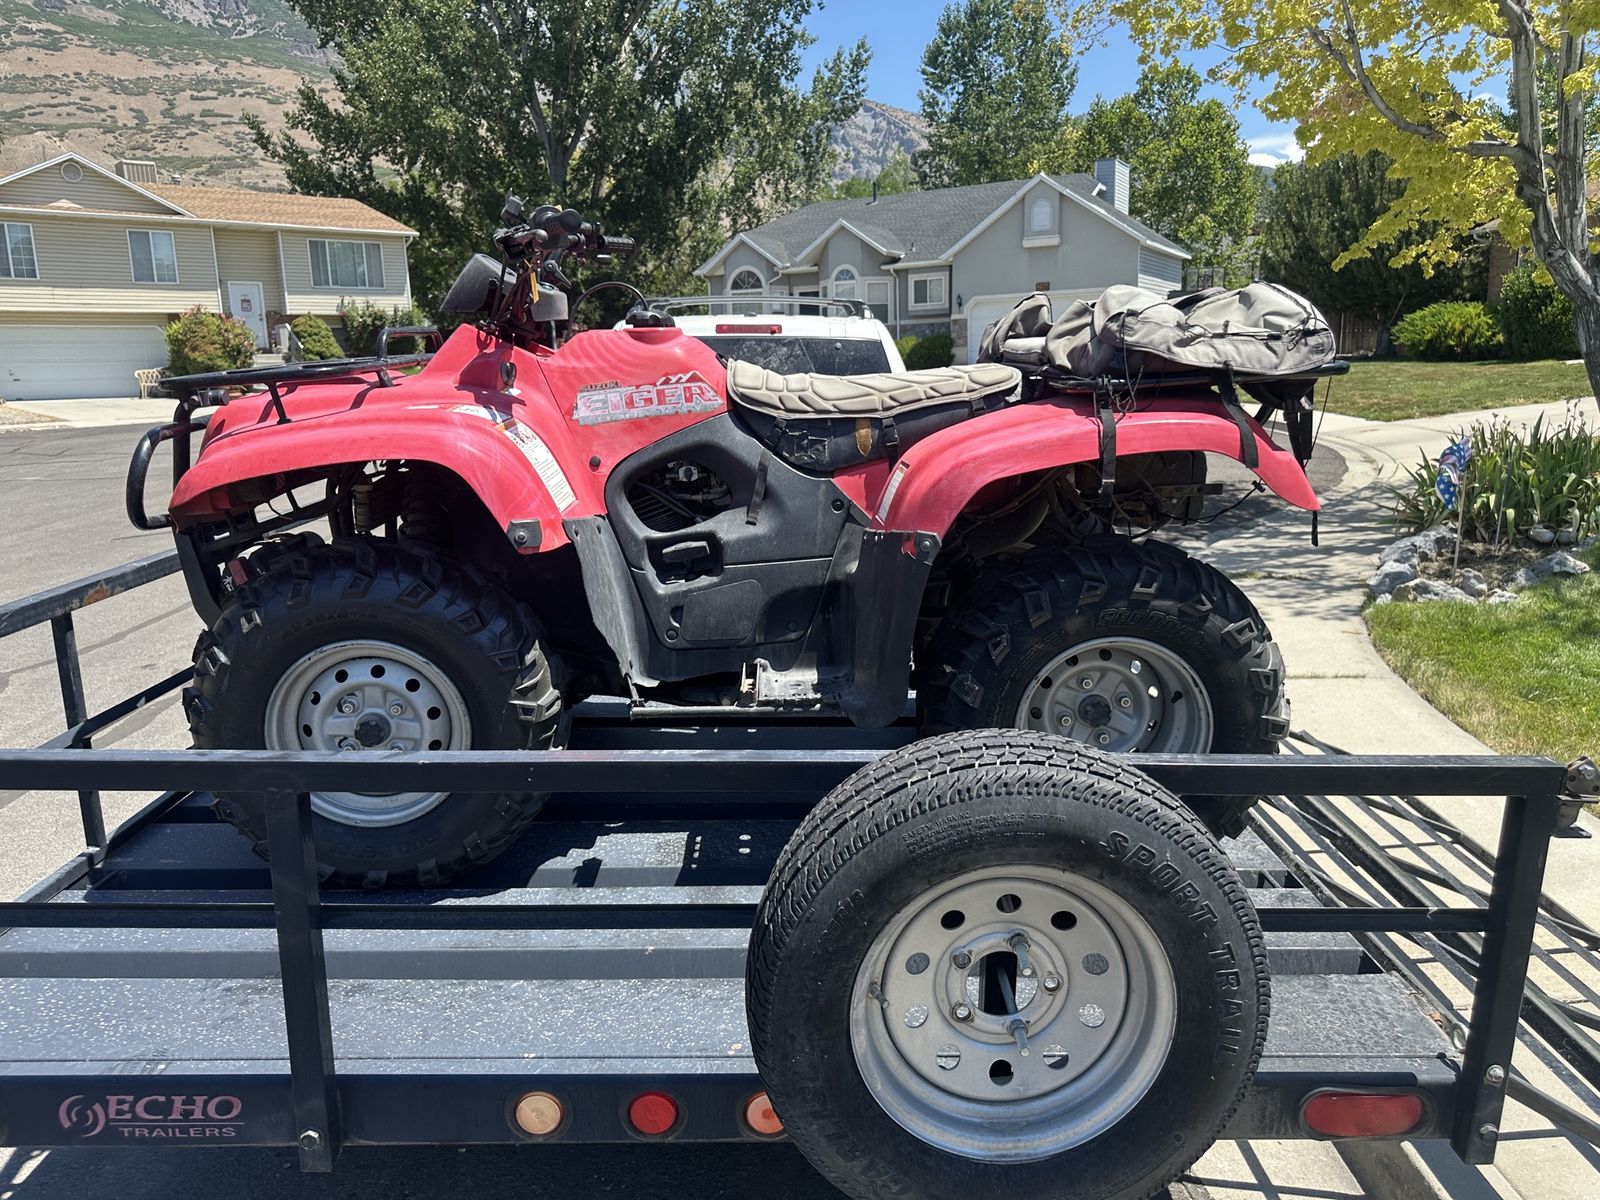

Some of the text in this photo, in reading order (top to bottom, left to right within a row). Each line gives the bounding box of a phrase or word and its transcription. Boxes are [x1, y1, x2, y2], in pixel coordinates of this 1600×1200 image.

[580, 381, 622, 392] SUZUKI
[574, 382, 723, 421] EIGER
[902, 822, 932, 842] SAFETY
[1099, 830, 1244, 1060] SPORT TRAIL
[105, 1095, 242, 1120] ECHO
[118, 1127, 237, 1138] TRAILERS
